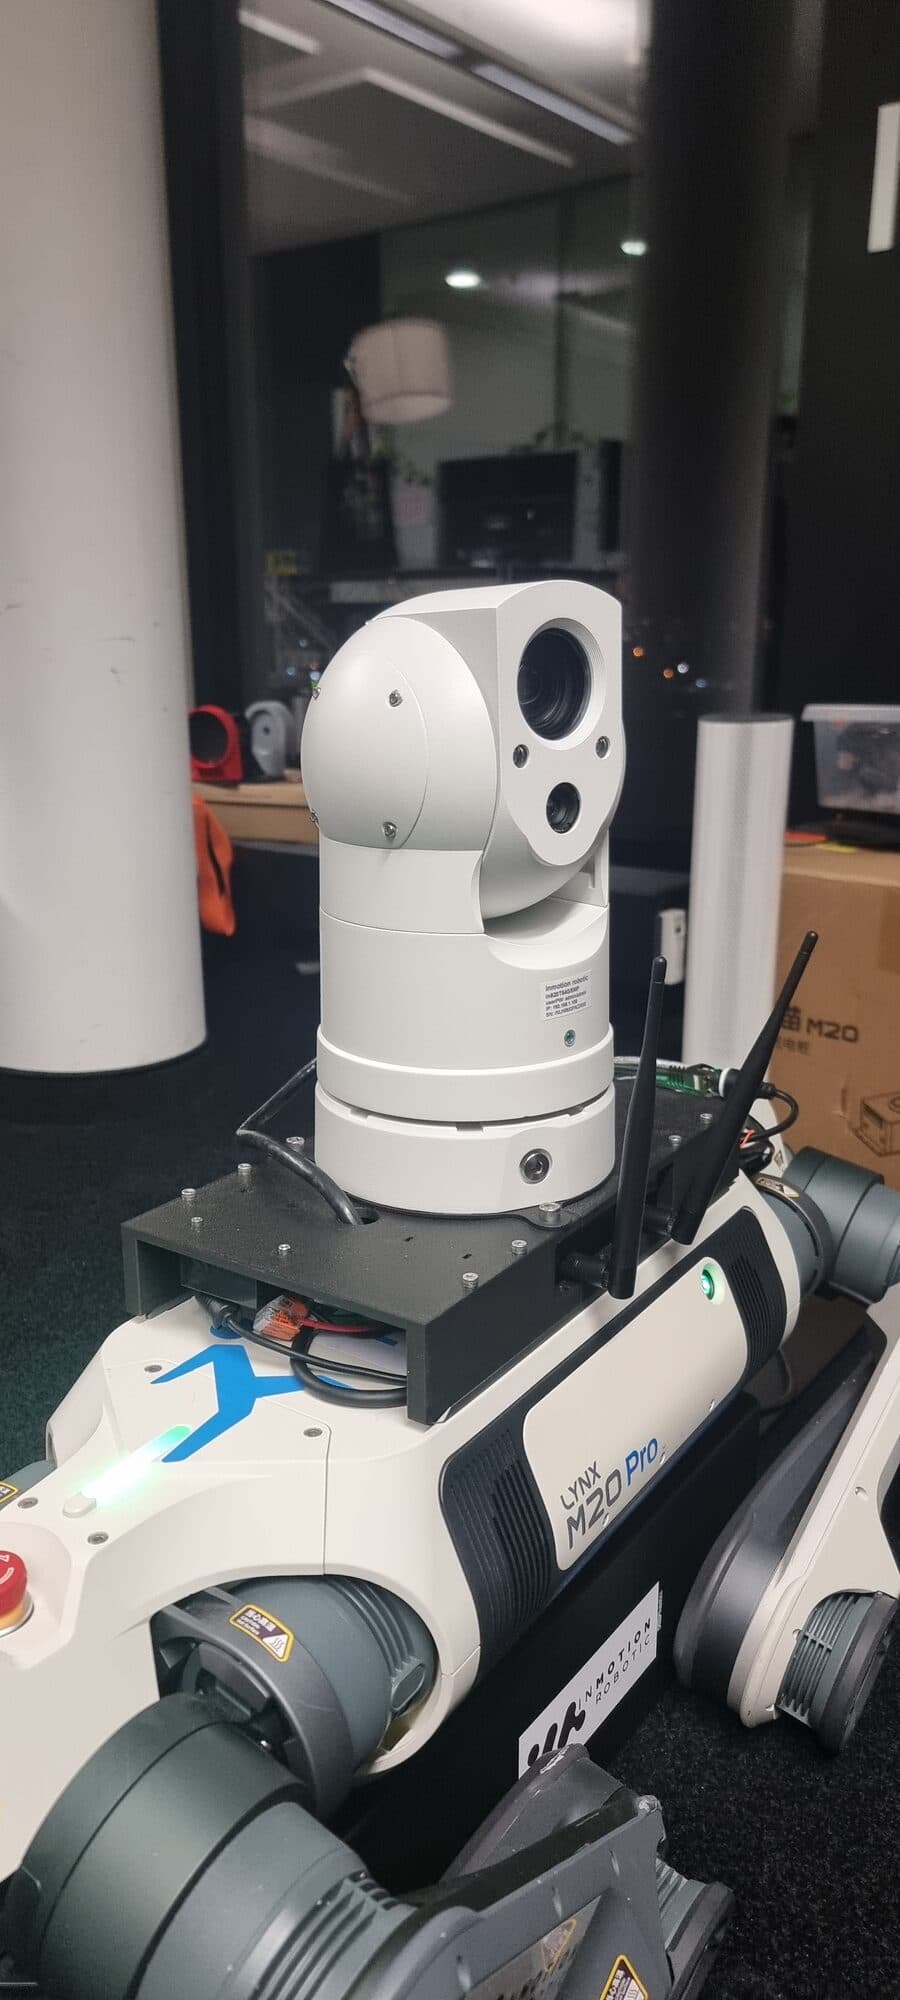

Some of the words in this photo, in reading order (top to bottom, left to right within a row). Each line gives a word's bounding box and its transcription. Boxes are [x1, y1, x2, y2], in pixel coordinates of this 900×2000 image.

[806, 1018, 859, 1043] M20
[560, 1461, 601, 1510] LYNX
[566, 1469, 622, 1550] M20
[625, 1438, 658, 1486] Pro
[578, 1618, 651, 1711] INMOTION
[596, 1634, 650, 1704] ROBOTIC
